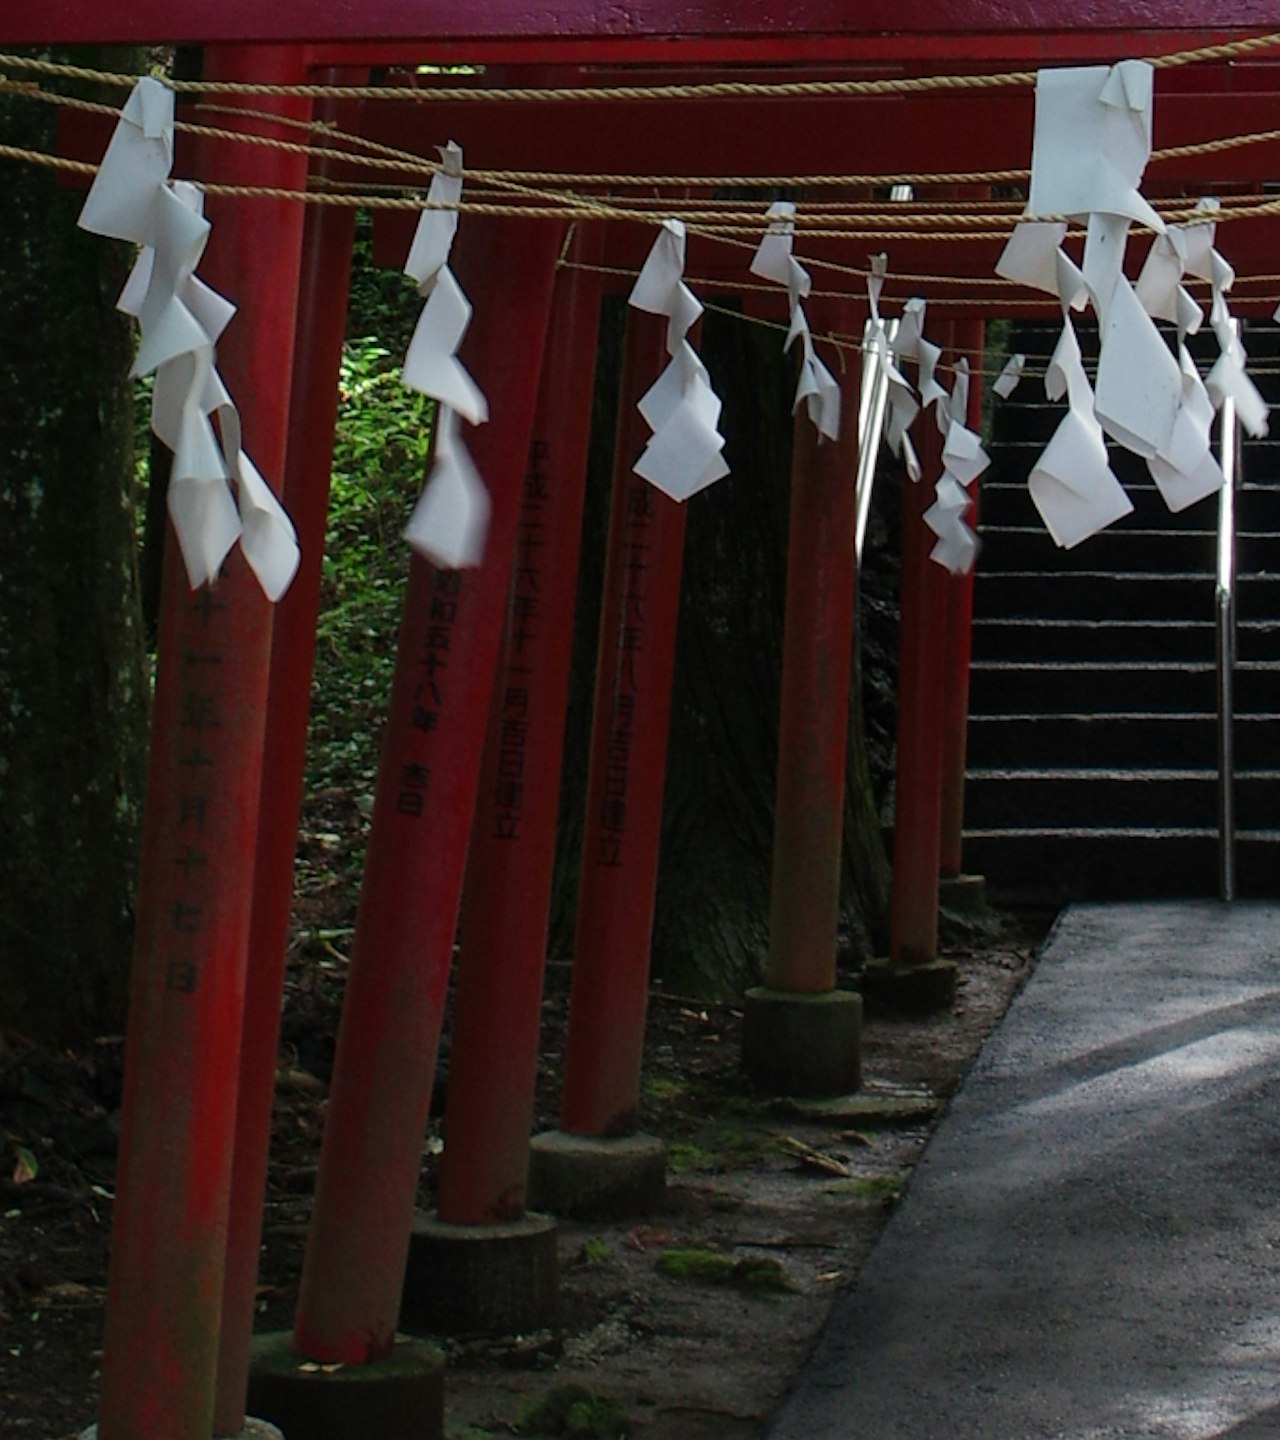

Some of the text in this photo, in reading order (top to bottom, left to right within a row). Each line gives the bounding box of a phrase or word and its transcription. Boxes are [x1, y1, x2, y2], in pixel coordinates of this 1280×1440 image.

[165, 567, 228, 993] 十一年十月十七日
